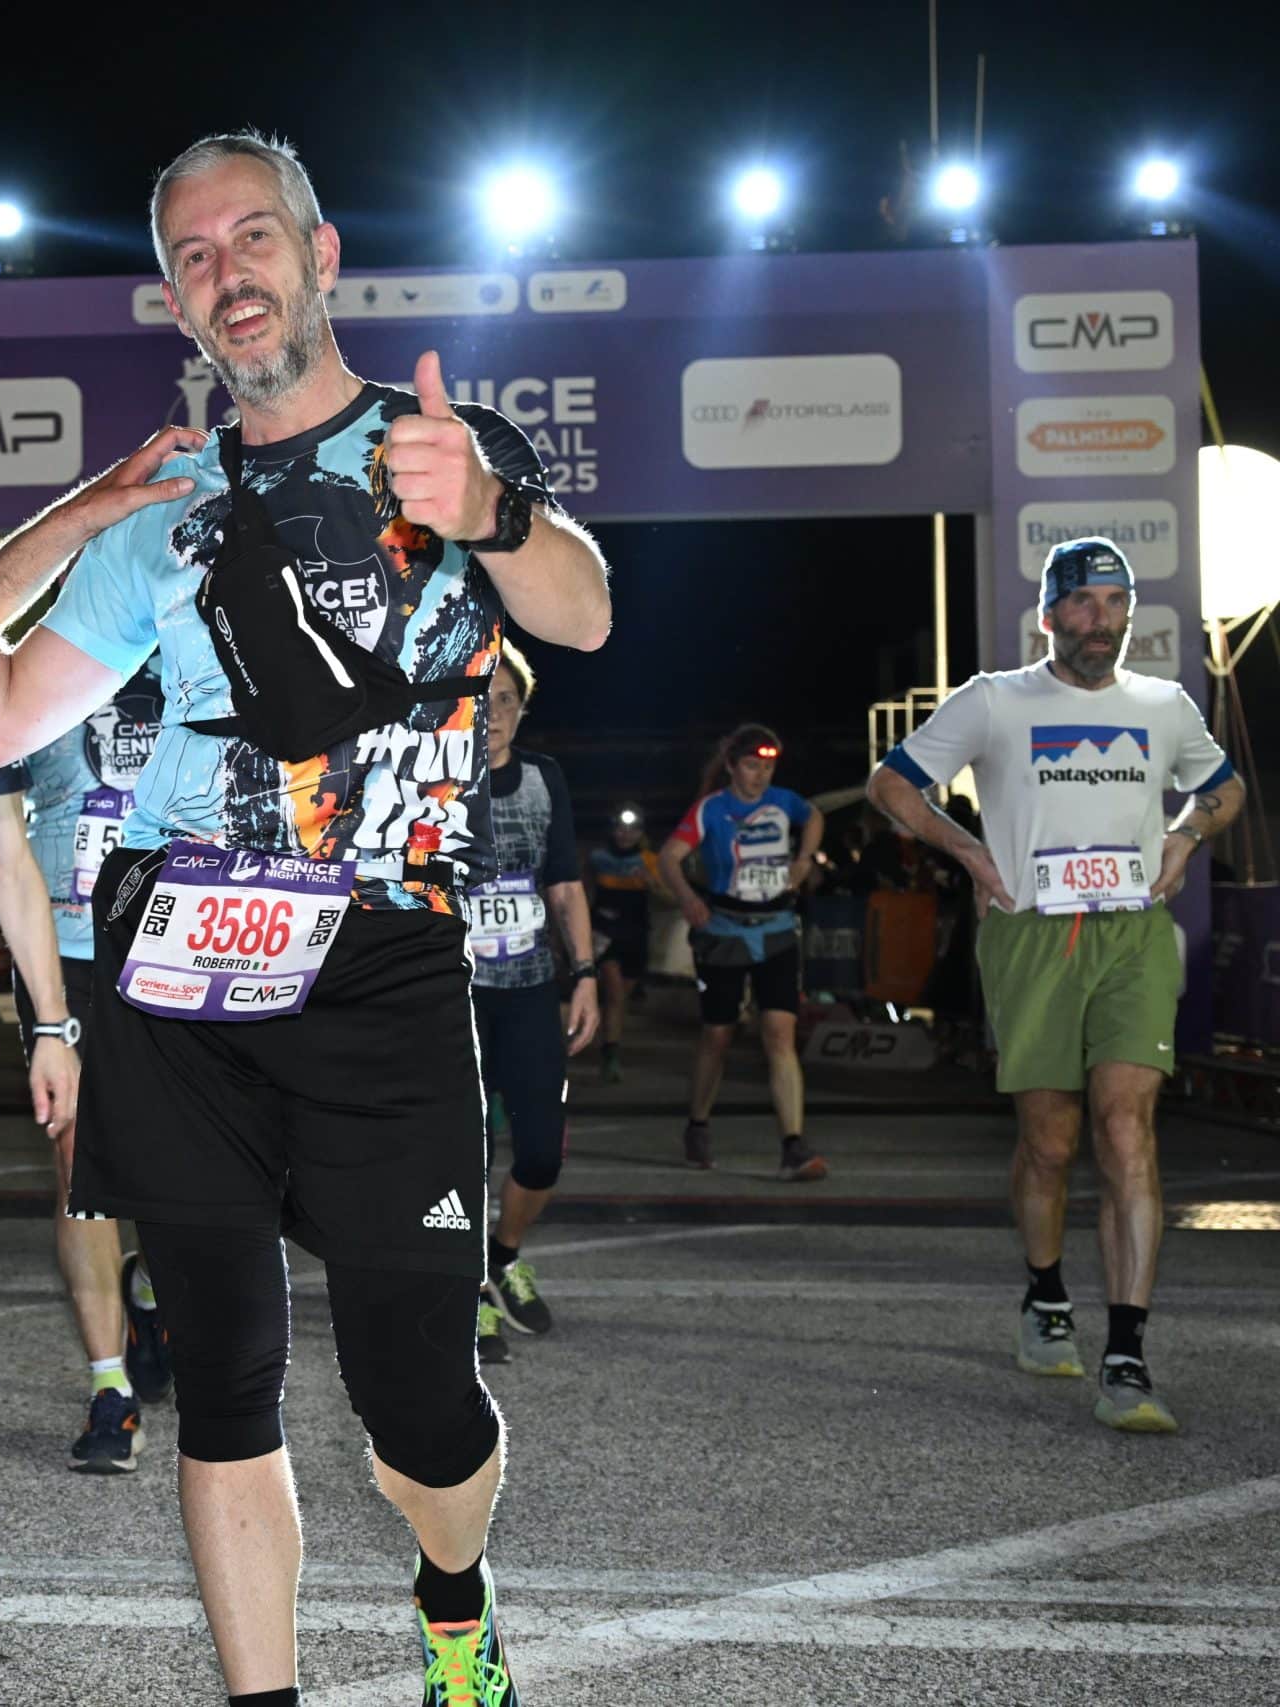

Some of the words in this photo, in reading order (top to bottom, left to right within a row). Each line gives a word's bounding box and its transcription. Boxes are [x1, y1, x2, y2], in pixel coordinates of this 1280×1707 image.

[1029, 313, 1159, 349] CMP
[532, 428, 598, 457] AIL
[552, 462, 599, 493] 25
[319, 611, 372, 628] AIL
[118, 721, 162, 736] CMP
[100, 738, 155, 754] VENI
[1038, 766, 1146, 786] patagonia
[172, 855, 220, 870] CMP
[268, 857, 342, 877] VENICE
[264, 868, 302, 882] NIGHT
[305, 873, 339, 885] TRAIL
[1062, 857, 1120, 891] 4353
[479, 896, 519, 926] F61
[187, 896, 294, 957] 3586
[193, 955, 251, 971] ROBERTO
[182, 984, 205, 994] Sport
[230, 984, 298, 1003] CMP
[821, 1030, 897, 1058] CMP
[423, 1213, 471, 1231] adidas
